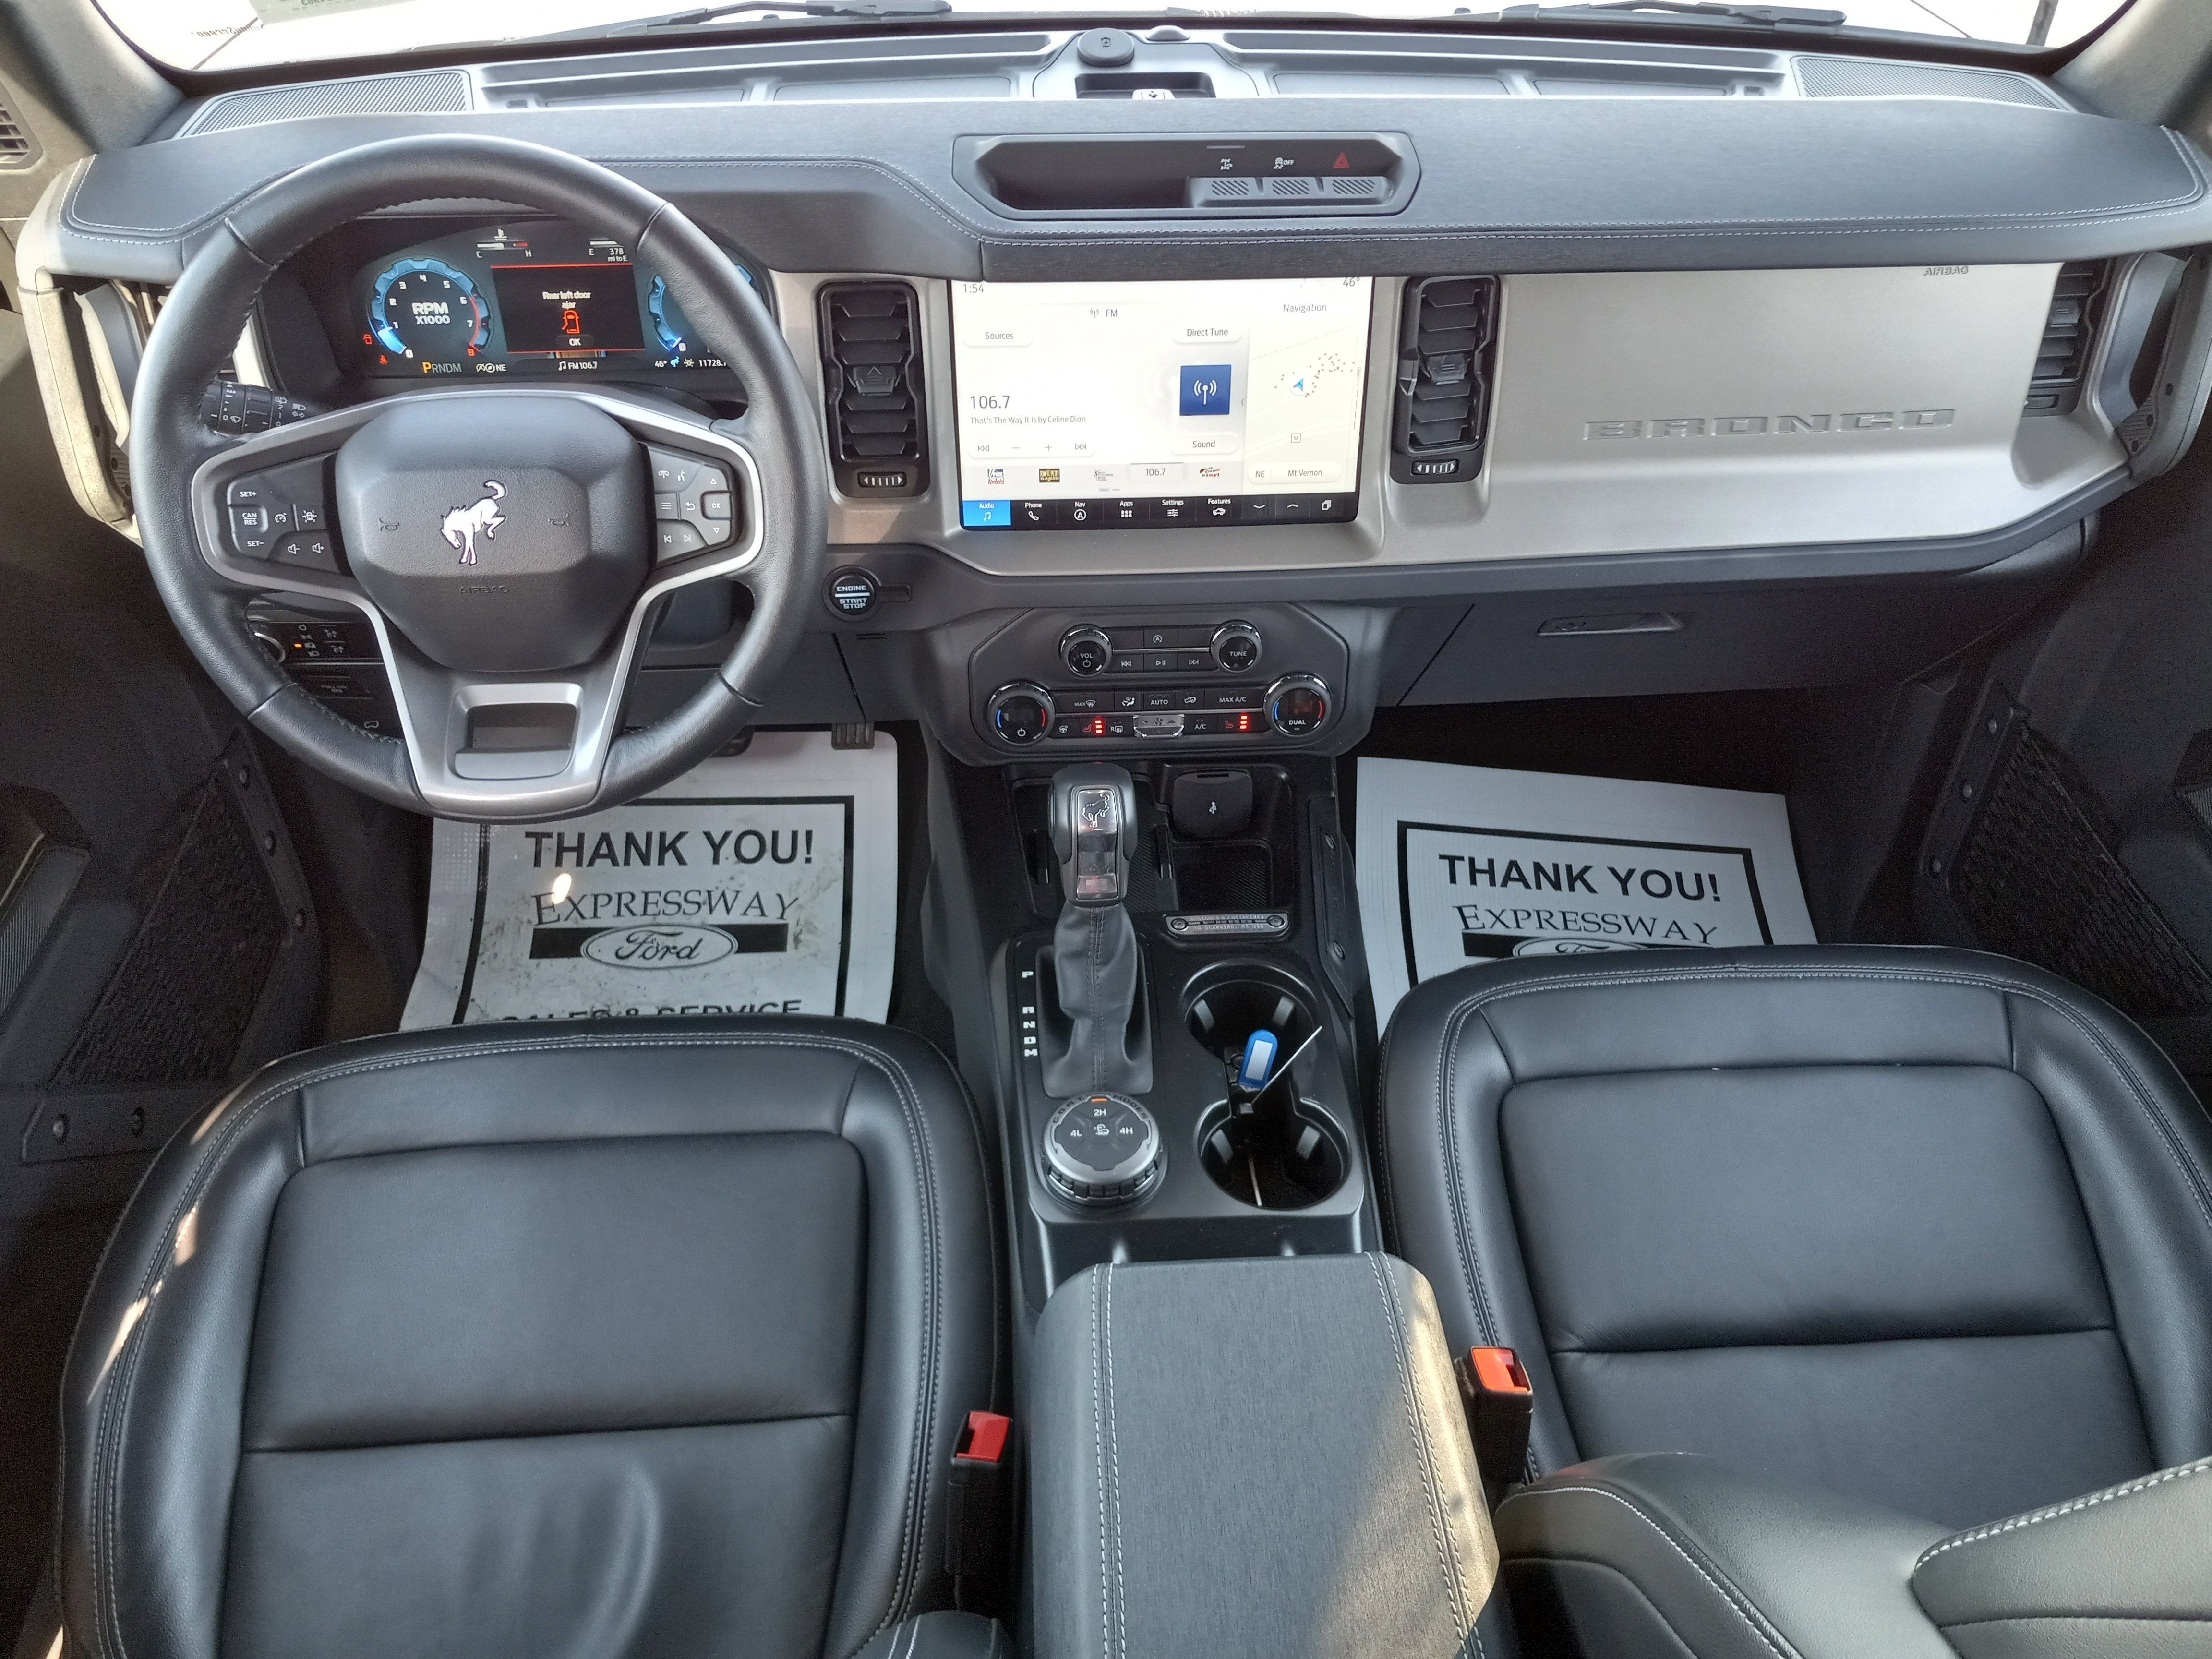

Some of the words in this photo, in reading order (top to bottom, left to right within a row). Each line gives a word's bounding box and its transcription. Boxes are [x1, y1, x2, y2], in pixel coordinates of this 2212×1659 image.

[1923, 266, 1970, 277] AIRBAG
[419, 274, 427, 282] 4
[399, 281, 407, 289] 3
[443, 280, 451, 289] 5
[963, 283, 985, 293] 1:54
[542, 291, 560, 300] Rear
[560, 290, 574, 299] left
[574, 291, 591, 299] door
[411, 302, 449, 315] RPM
[562, 301, 576, 310] ajar
[1283, 303, 1327, 313] Navigation
[1106, 309, 1118, 317] FM
[415, 315, 450, 325] X1000
[985, 332, 1014, 340] Sources
[1187, 328, 1208, 337] Direct
[1210, 328, 1228, 336] Tune
[569, 338, 581, 346] OK
[405, 349, 414, 358] 0
[496, 363, 507, 372] NE
[579, 361, 598, 369] 106.7
[970, 395, 1010, 409] 106.7
[1008, 416, 1023, 425] Way
[1038, 416, 1046, 424] by
[1583, 409, 1956, 440] BRONCO
[1192, 440, 1216, 448] Sound
[1146, 468, 1166, 477] 106.7
[1120, 500, 1134, 508] Apps
[1162, 498, 1184, 507] Settings
[460, 586, 510, 594] AIRBAG
[524, 830, 690, 868] THANK
[702, 829, 814, 866] YOU!
[1438, 854, 1599, 895] THANK
[1606, 866, 1721, 902] YOU!
[531, 889, 800, 926] EXPRESSWAY
[1453, 903, 1718, 945] EXPRESSWAY
[614, 929, 705, 961] Ford
[1023, 1021, 1036, 1029] N
[1024, 1036, 1036, 1045] D
[1024, 1048, 1038, 1057] M
[1113, 1094, 1148, 1119] MODES
[1094, 1108, 1107, 1117] 2H
[1070, 1129, 1082, 1137] 4L
[1119, 1127, 1133, 1135] 4H
